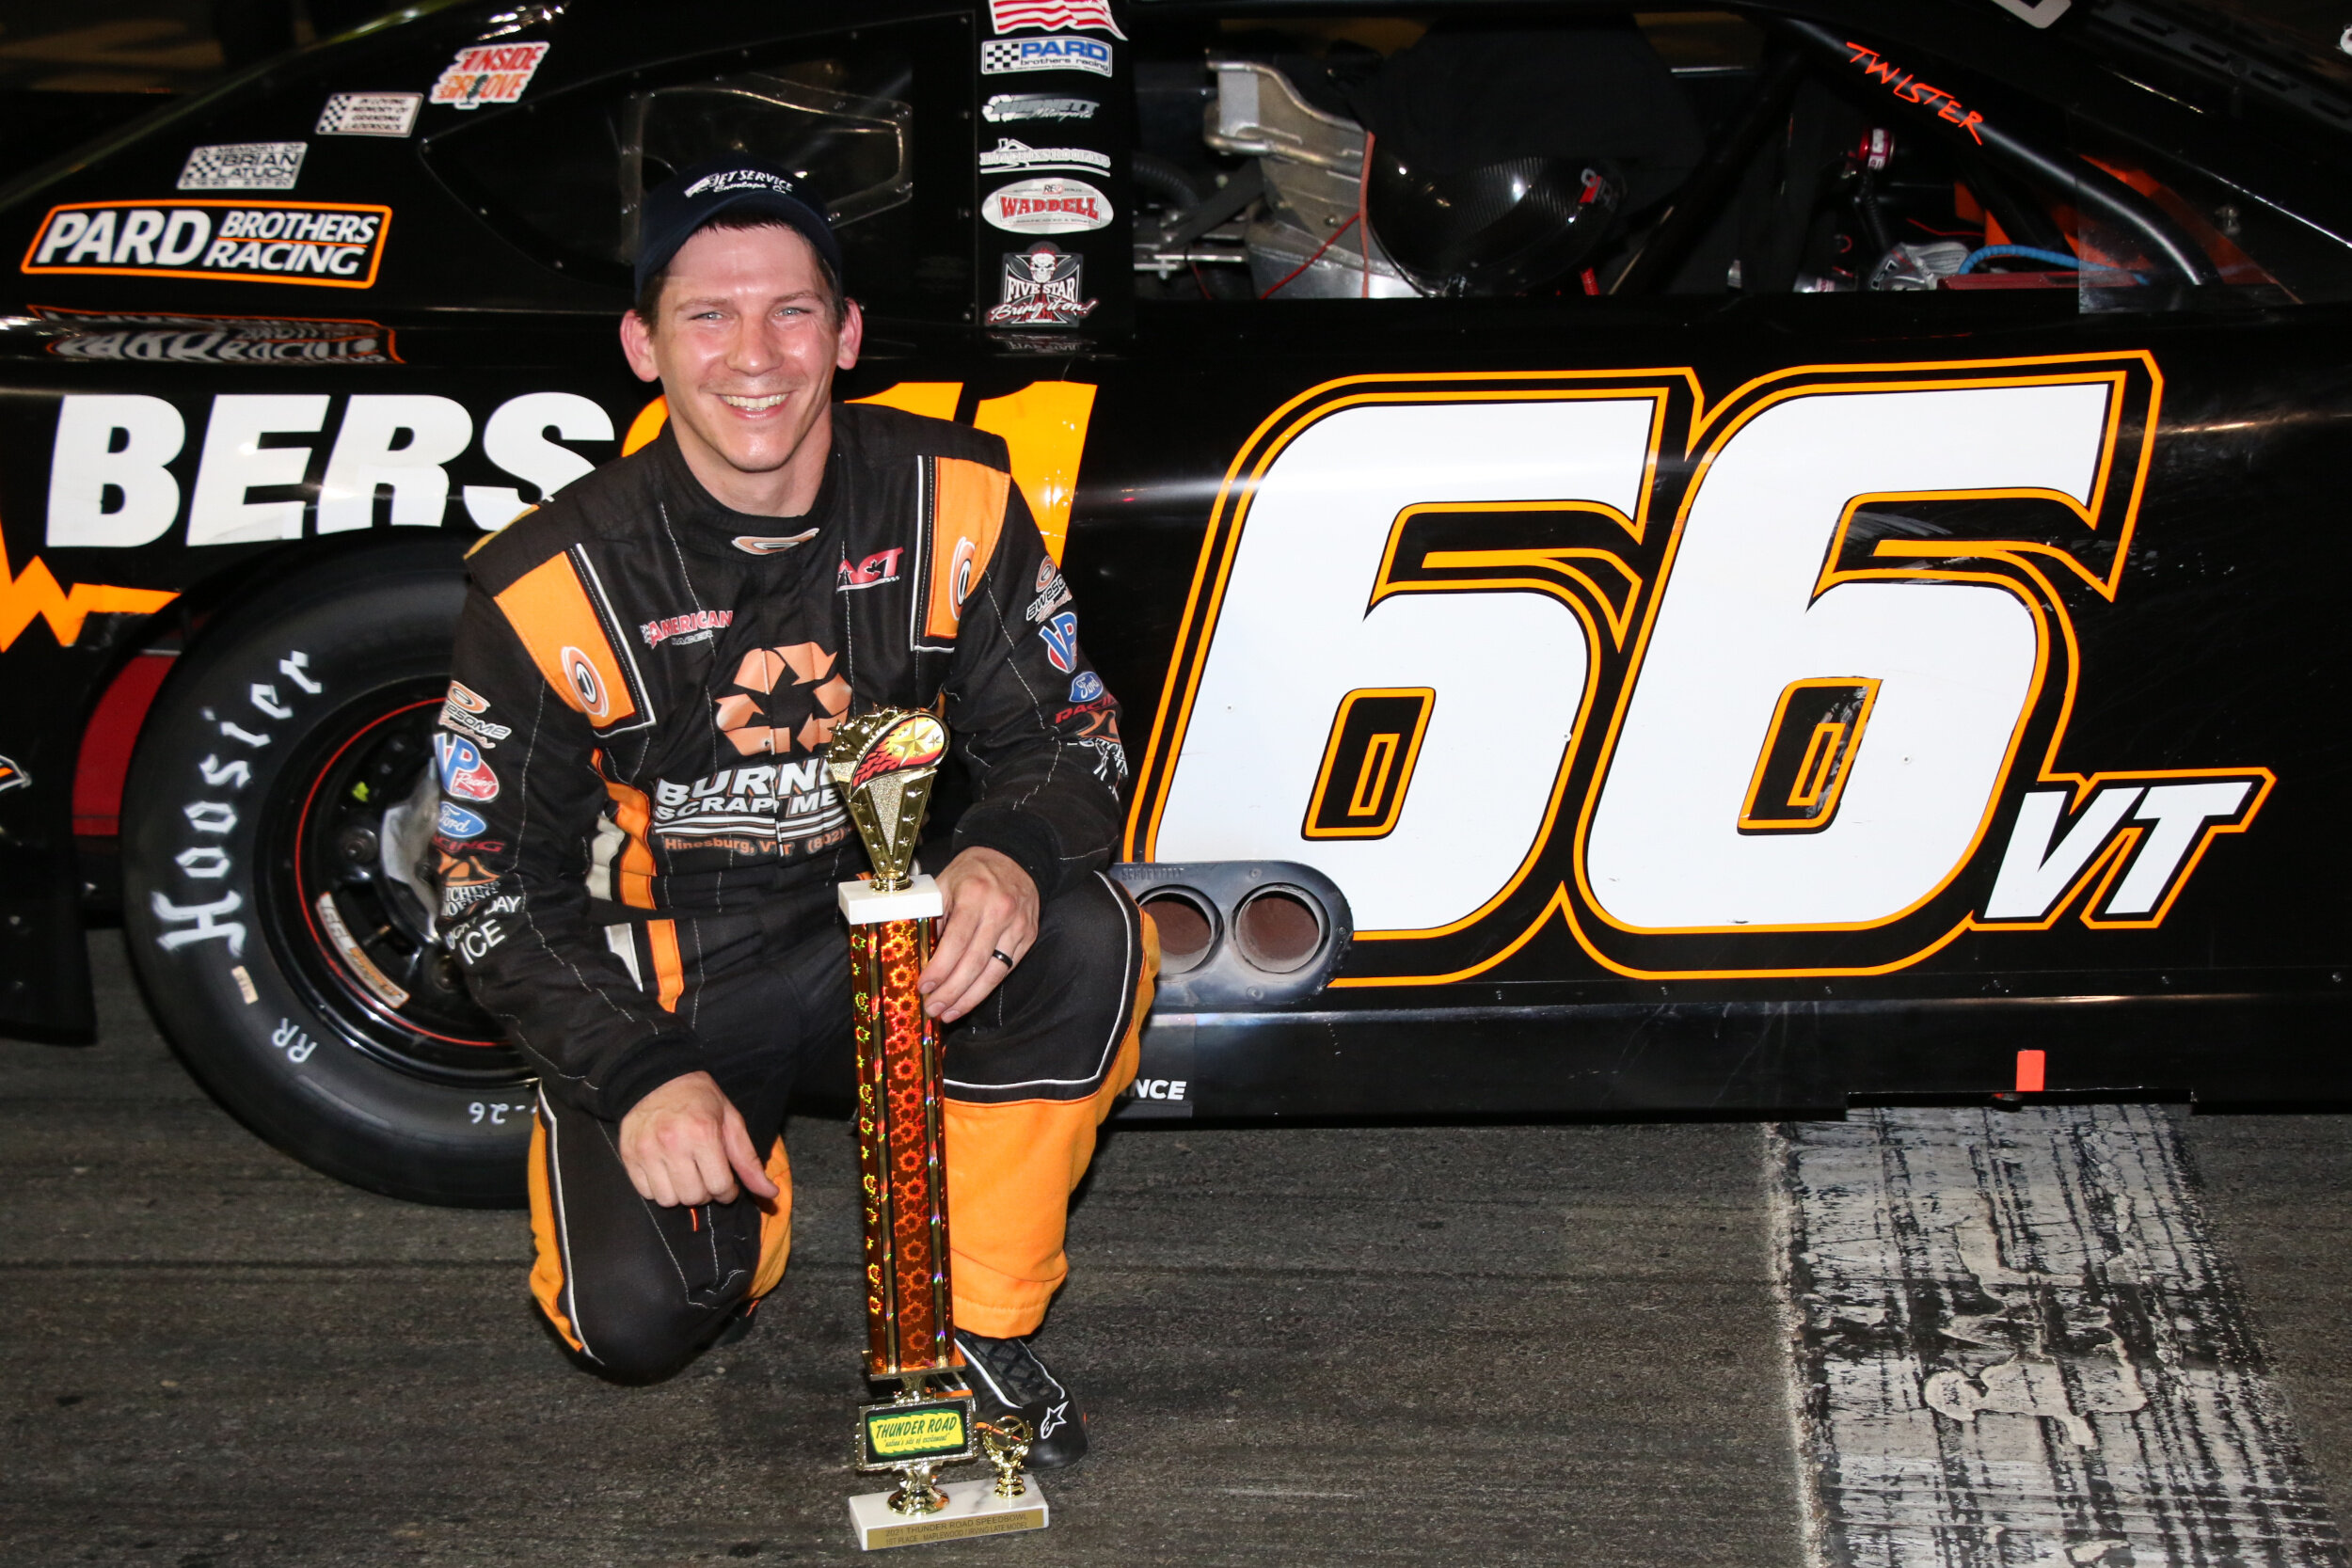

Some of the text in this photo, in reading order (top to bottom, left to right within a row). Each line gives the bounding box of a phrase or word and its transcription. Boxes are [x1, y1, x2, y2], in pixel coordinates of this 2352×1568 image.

[1022, 40, 1108, 62] PARD
[1075, 58, 1108, 71] racing
[1847, 41, 1982, 145] TWISTER
[221, 153, 300, 166] BRIAN
[739, 170, 793, 192] SERVICE
[1000, 196, 1099, 220] WADDELL
[36, 209, 212, 265] PARD
[218, 211, 379, 244] BROTHERS
[202, 239, 365, 275] RACING
[1006, 276, 1077, 303] FIVE STAR
[991, 301, 1046, 322] Bring
[648, 610, 733, 649] AMERICAN
[1039, 611, 1077, 673] VP
[1144, 371, 2128, 939] 66
[1076, 676, 1100, 699] Ford
[434, 733, 481, 793] VP
[151, 651, 322, 958] Hoosier
[655, 787, 839, 821] SCRAP ME
[439, 805, 471, 832] Ford
[665, 836, 755, 854] Hinesburg,
[1984, 782, 2252, 918] VT
[460, 919, 505, 965] ICE
[1134, 1078, 1187, 1101] NCE
[876, 1417, 958, 1439] THUNDER ROAD
[898, 1535, 918, 1544] PLACE
[923, 1529, 964, 1542] MAPLEWOOD
[968, 1526, 990, 1535] IRVING
[991, 1524, 1005, 1533] LATE
[1007, 1521, 1029, 1530] MODEL
[907, 1522, 947, 1534] THUNDER
[950, 1519, 974, 1529] ROAD
[977, 1513, 1029, 1526] SPEEDBOWL
